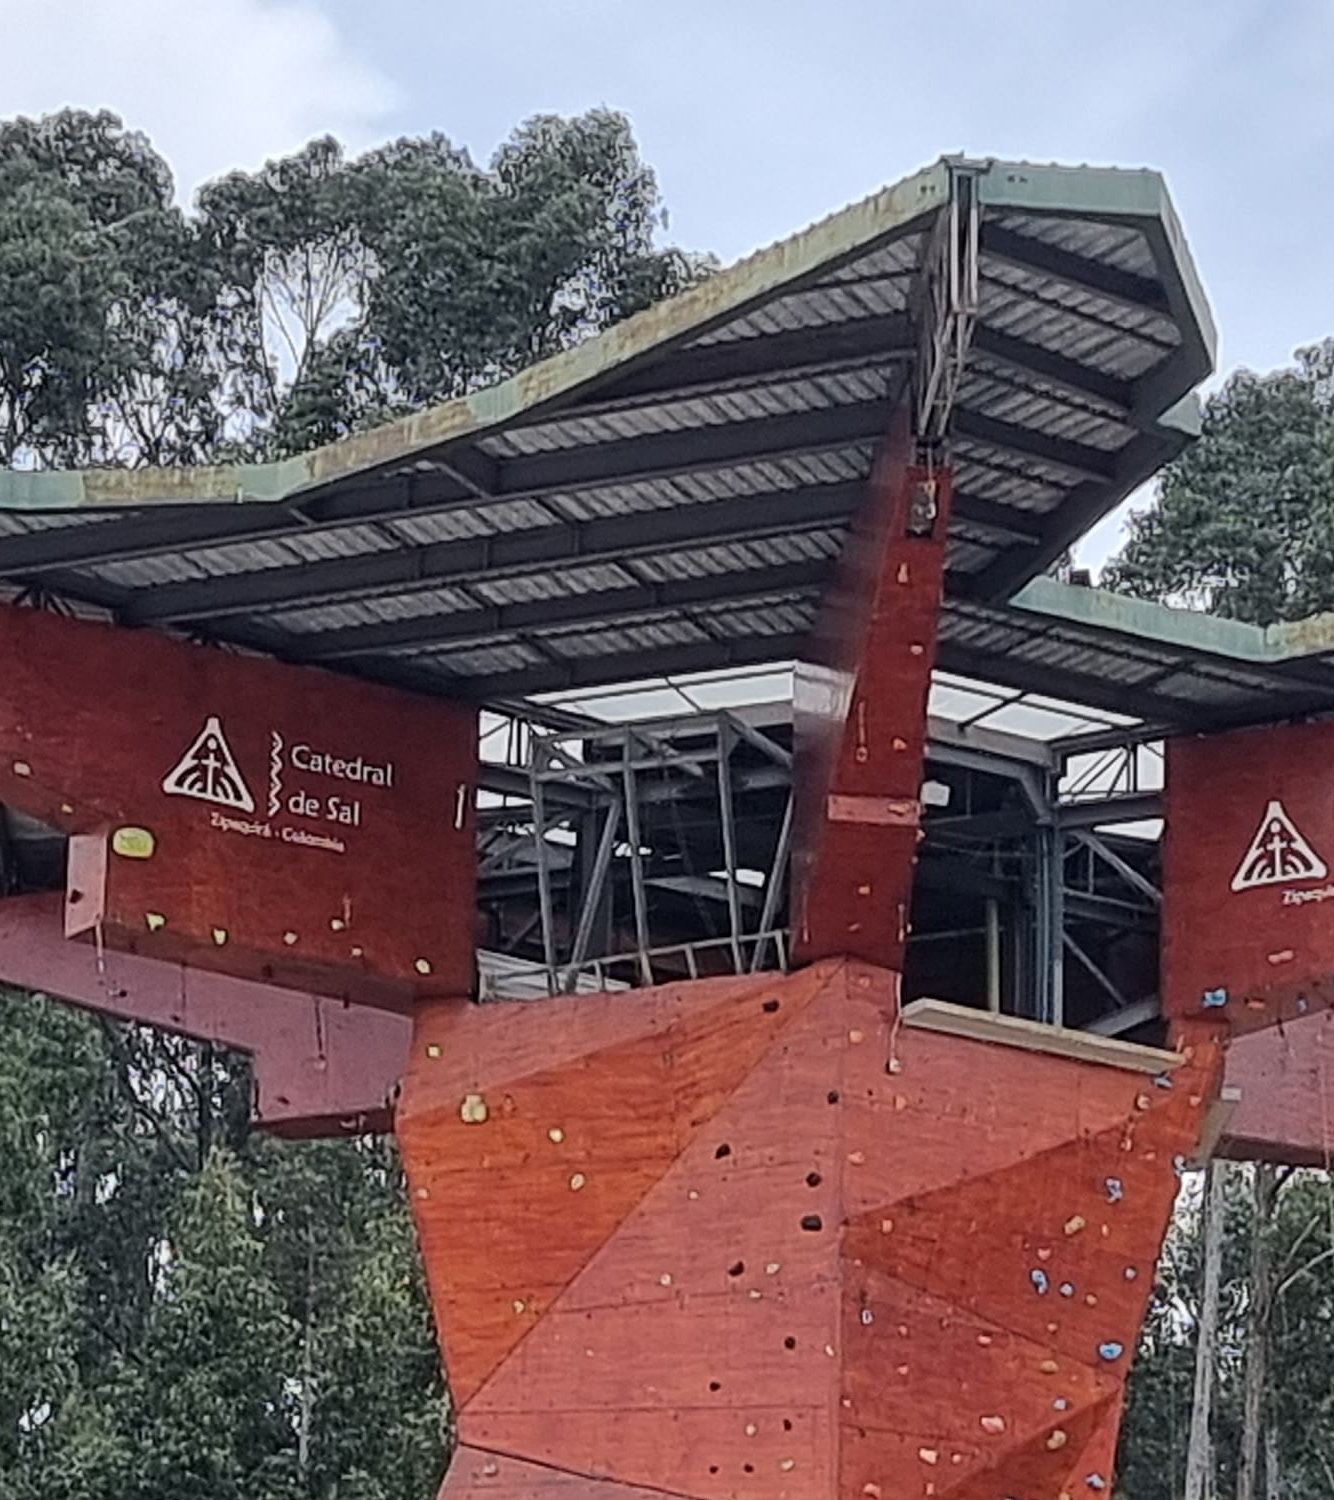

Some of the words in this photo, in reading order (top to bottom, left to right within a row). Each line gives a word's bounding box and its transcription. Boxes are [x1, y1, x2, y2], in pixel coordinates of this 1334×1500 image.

[291, 745, 393, 787] Catedral
[288, 790, 320, 817] de
[326, 796, 360, 827] Sal
